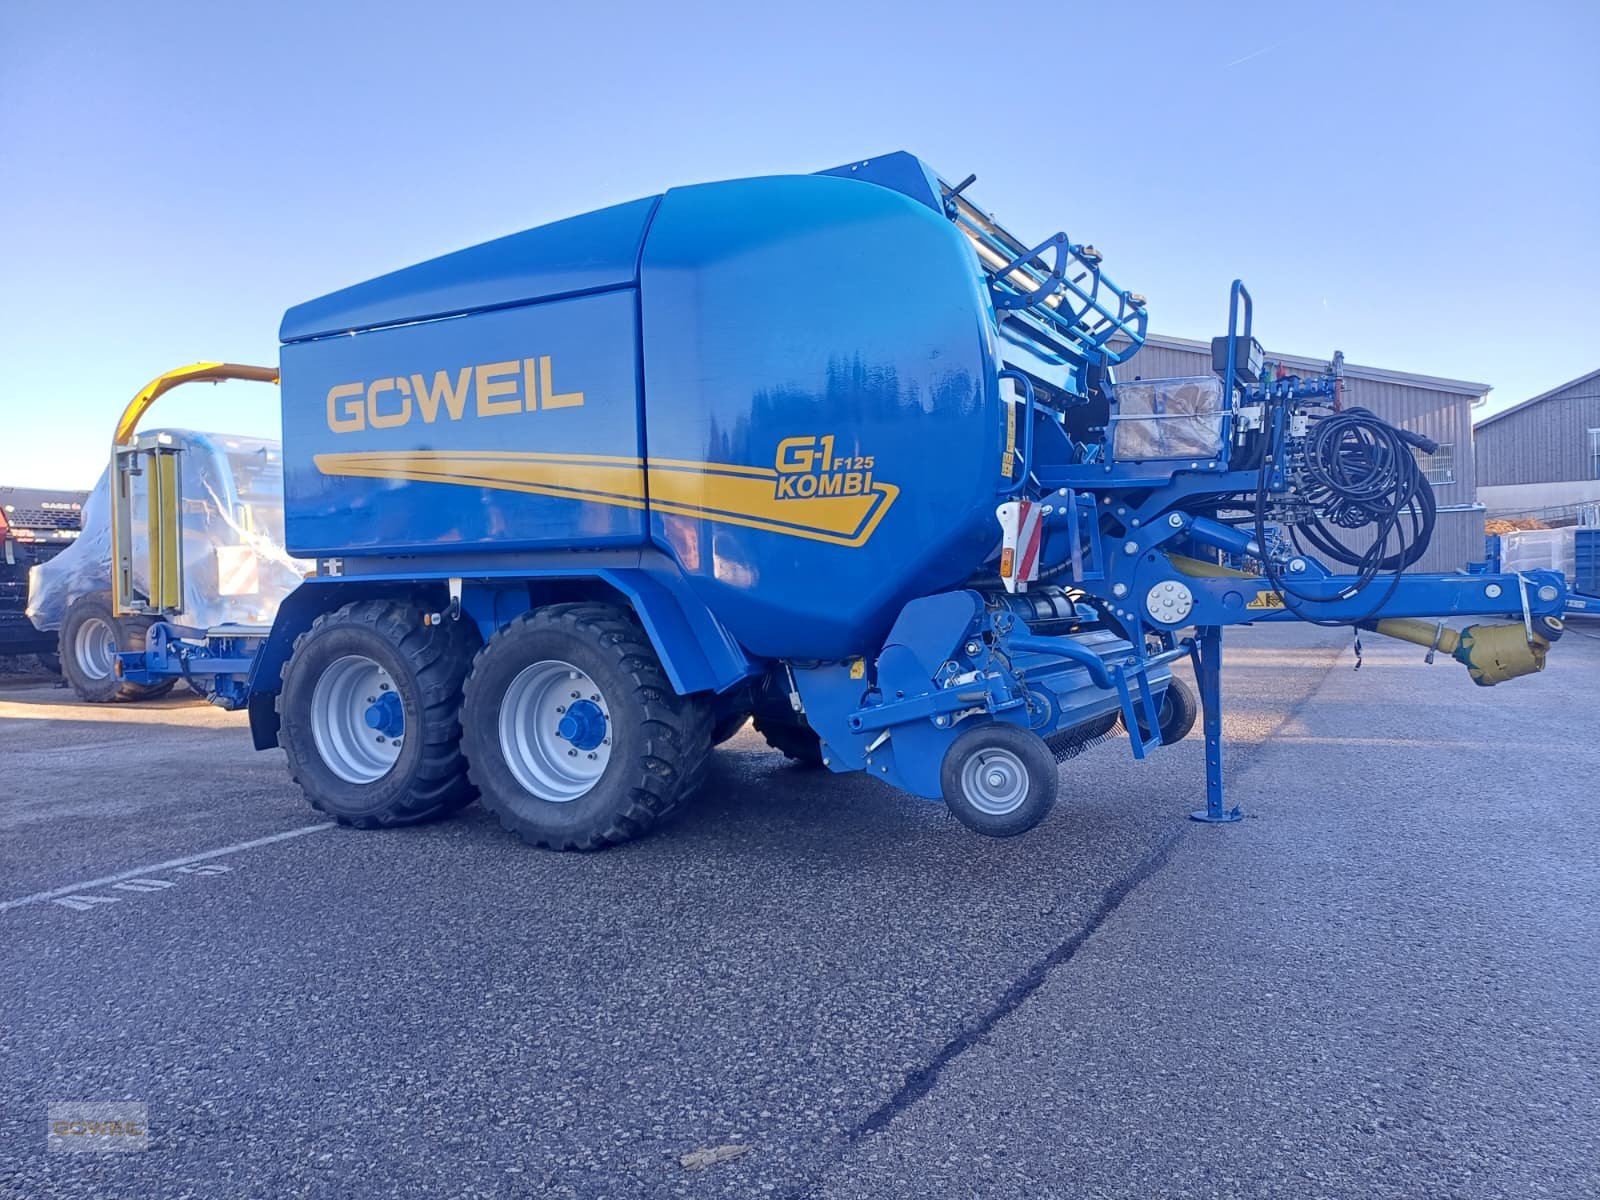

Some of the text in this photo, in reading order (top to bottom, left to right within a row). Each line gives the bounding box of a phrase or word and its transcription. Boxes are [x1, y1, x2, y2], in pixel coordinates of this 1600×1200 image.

[775, 435, 875, 473] G-1 F125
[777, 472, 872, 498] KOMBI
